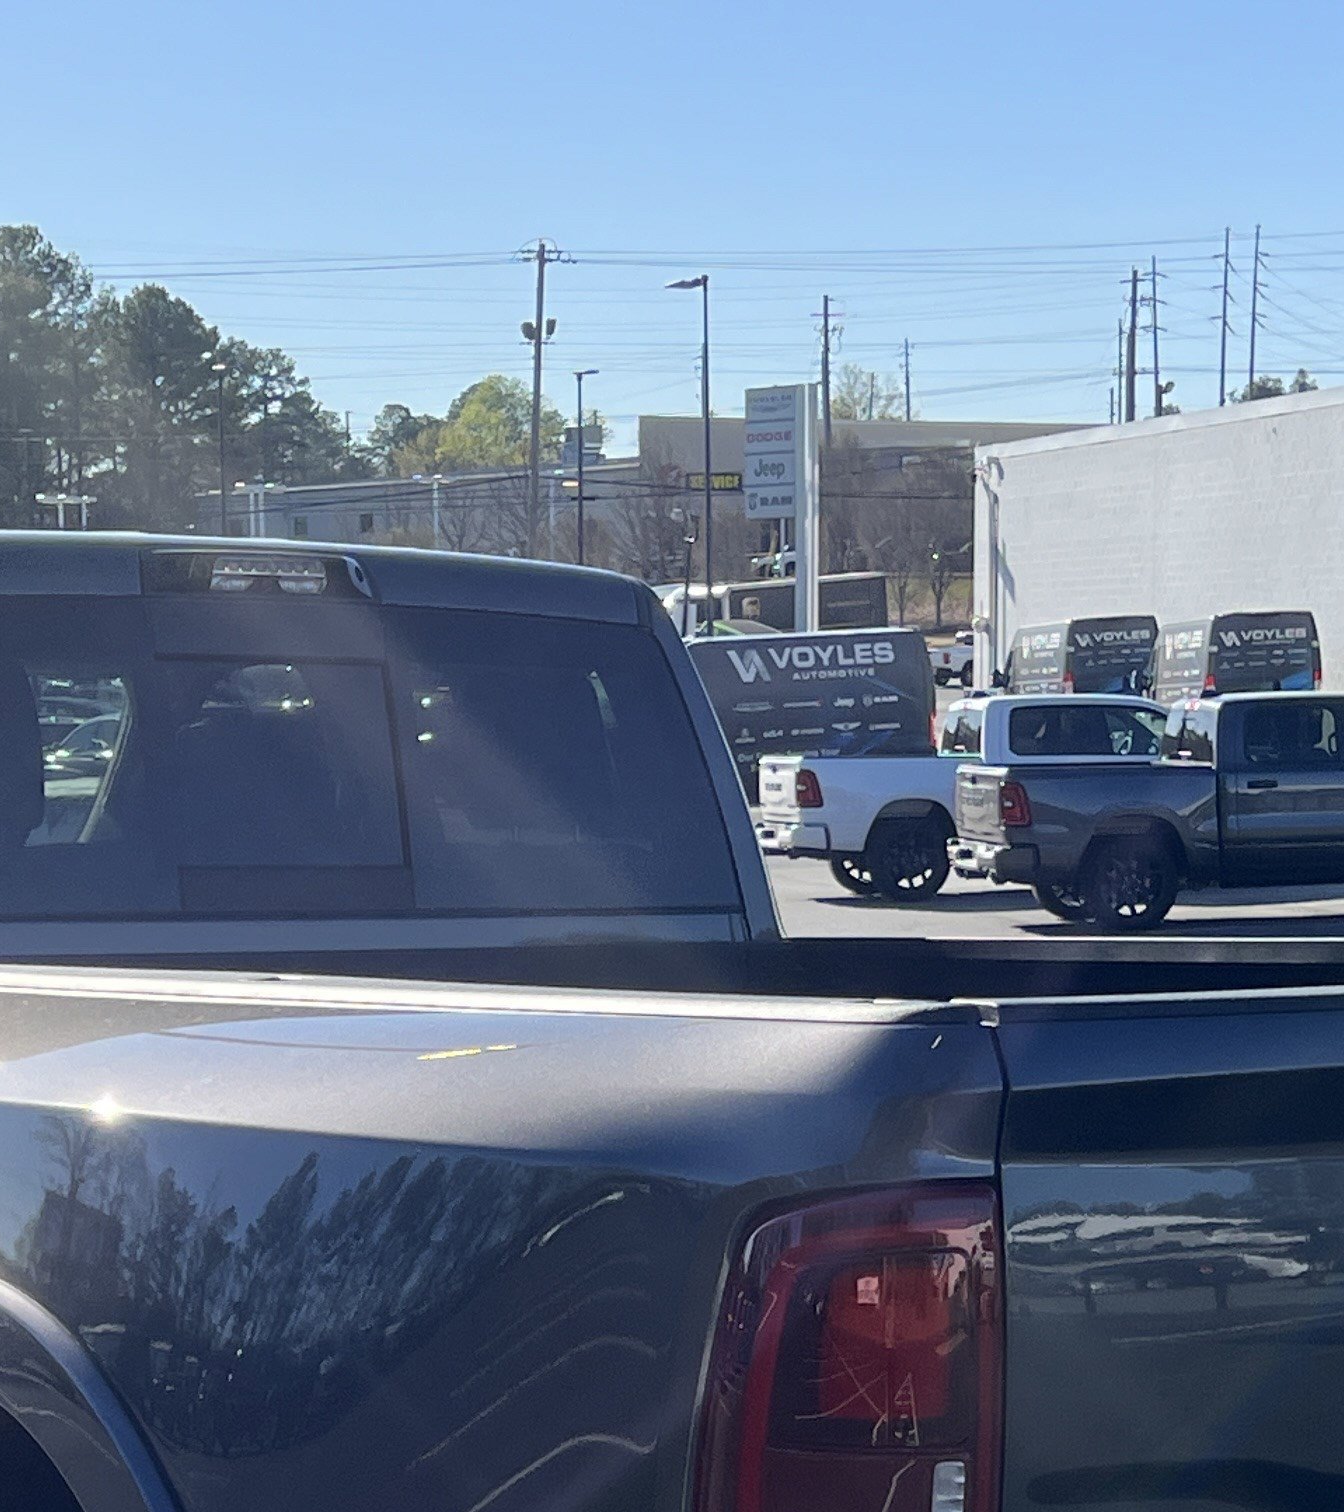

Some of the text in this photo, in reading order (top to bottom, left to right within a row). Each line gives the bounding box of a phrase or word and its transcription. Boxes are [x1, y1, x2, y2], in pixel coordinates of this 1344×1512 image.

[754, 459, 786, 480] Jeep
[688, 474, 740, 489] SEVICE
[759, 496, 793, 507] RAM
[1093, 629, 1151, 643] VOYLES
[1240, 627, 1307, 641] VOYLES
[767, 641, 896, 669] VOYLES
[792, 667, 875, 681] AUTOMOTIVE
